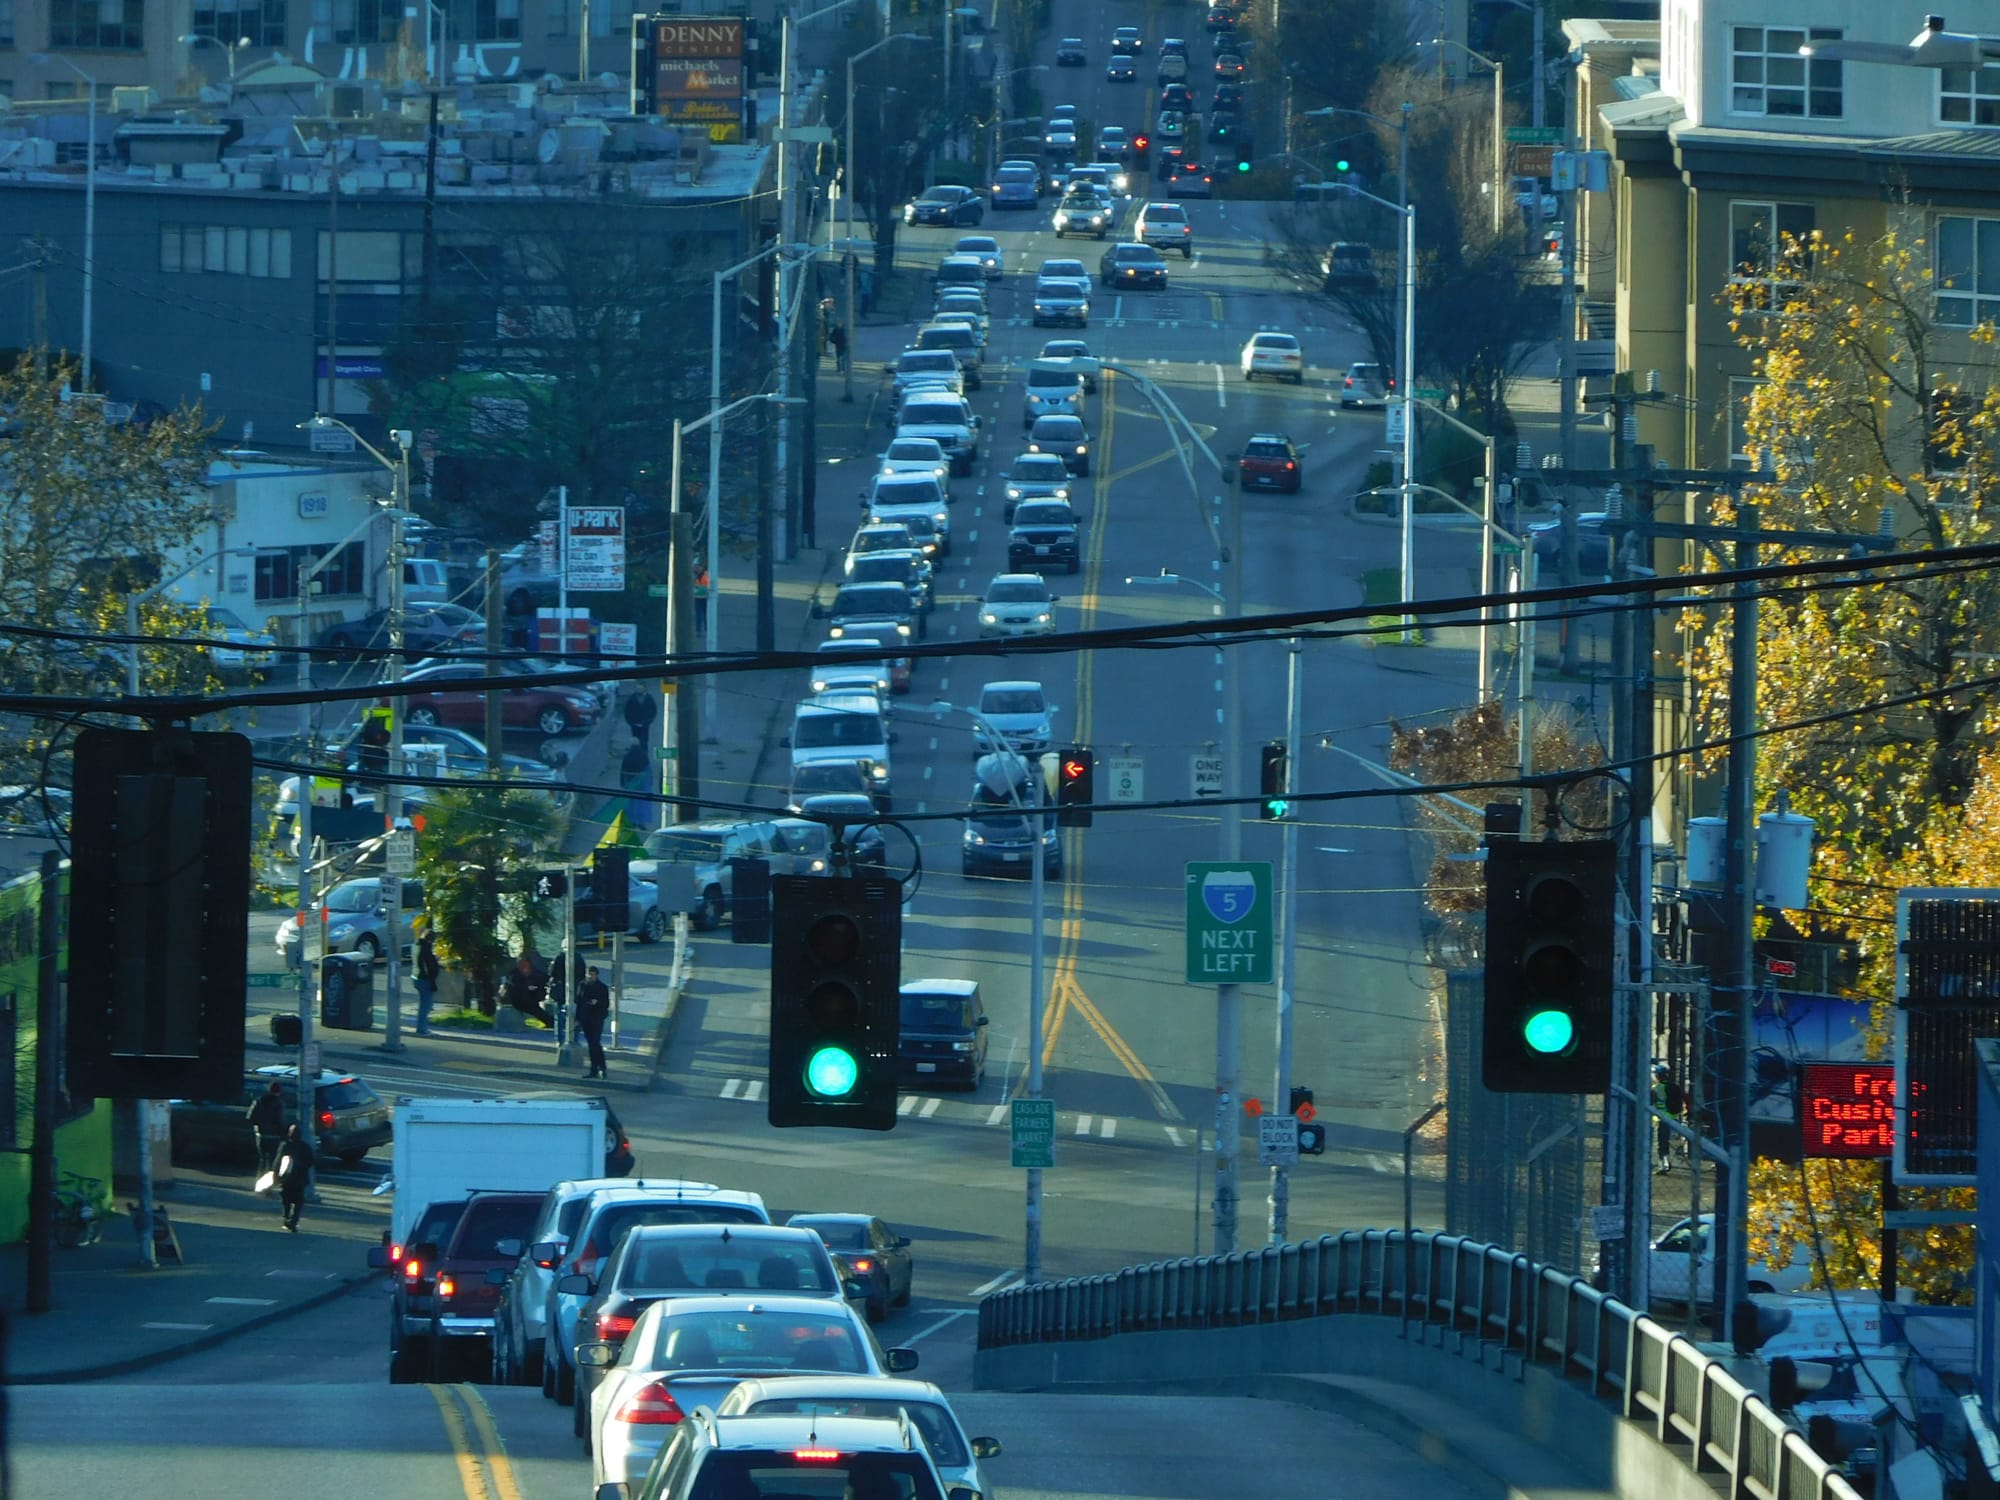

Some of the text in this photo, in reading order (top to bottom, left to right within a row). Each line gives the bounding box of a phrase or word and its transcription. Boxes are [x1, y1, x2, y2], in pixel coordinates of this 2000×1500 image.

[660, 26, 738, 42] DENNY
[1195, 760, 1223, 771] ONE
[1195, 772, 1222, 783] WAY
[1223, 892, 1238, 913] 5
[1202, 930, 1257, 949] NEXT
[1203, 953, 1256, 973] LEFT
[1262, 1132, 1294, 1143] BLOCK
